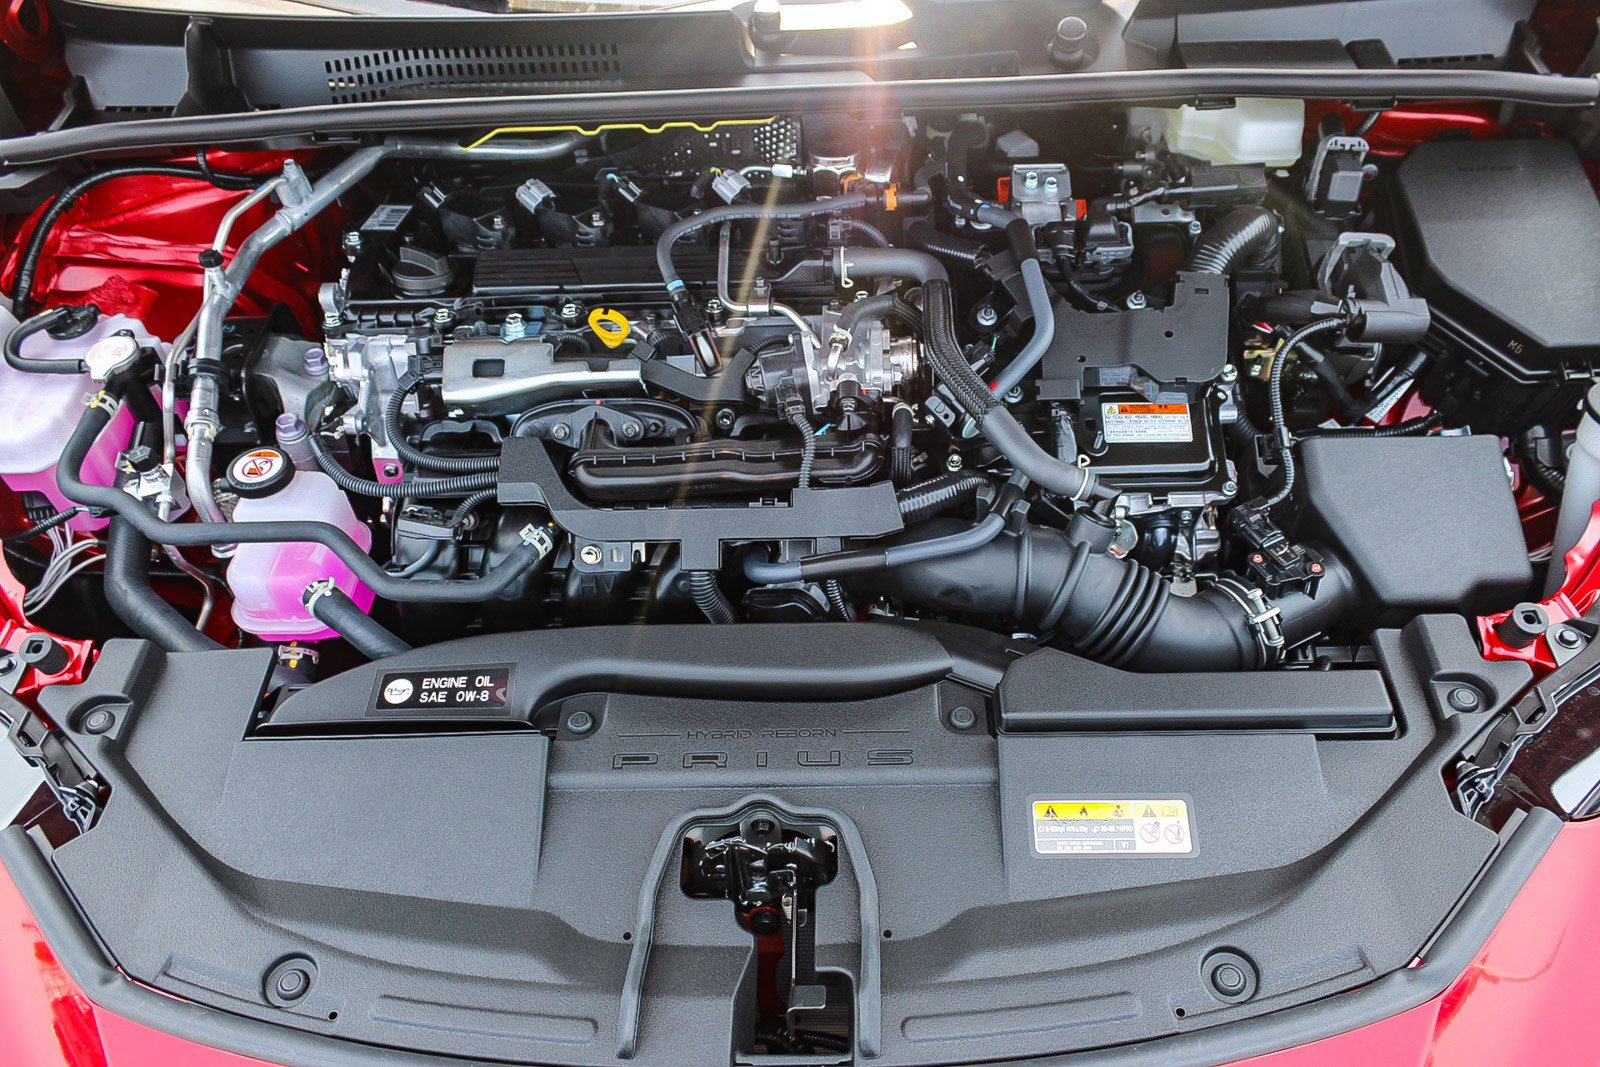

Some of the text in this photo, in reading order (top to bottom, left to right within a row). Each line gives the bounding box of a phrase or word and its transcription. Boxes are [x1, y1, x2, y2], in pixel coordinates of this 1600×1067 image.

[422, 675, 495, 689] ENGINE OIL
[419, 690, 490, 703] SAE 0W-8
[687, 728, 837, 740] HYBRID REBORN
[612, 750, 914, 770] PRIUS
